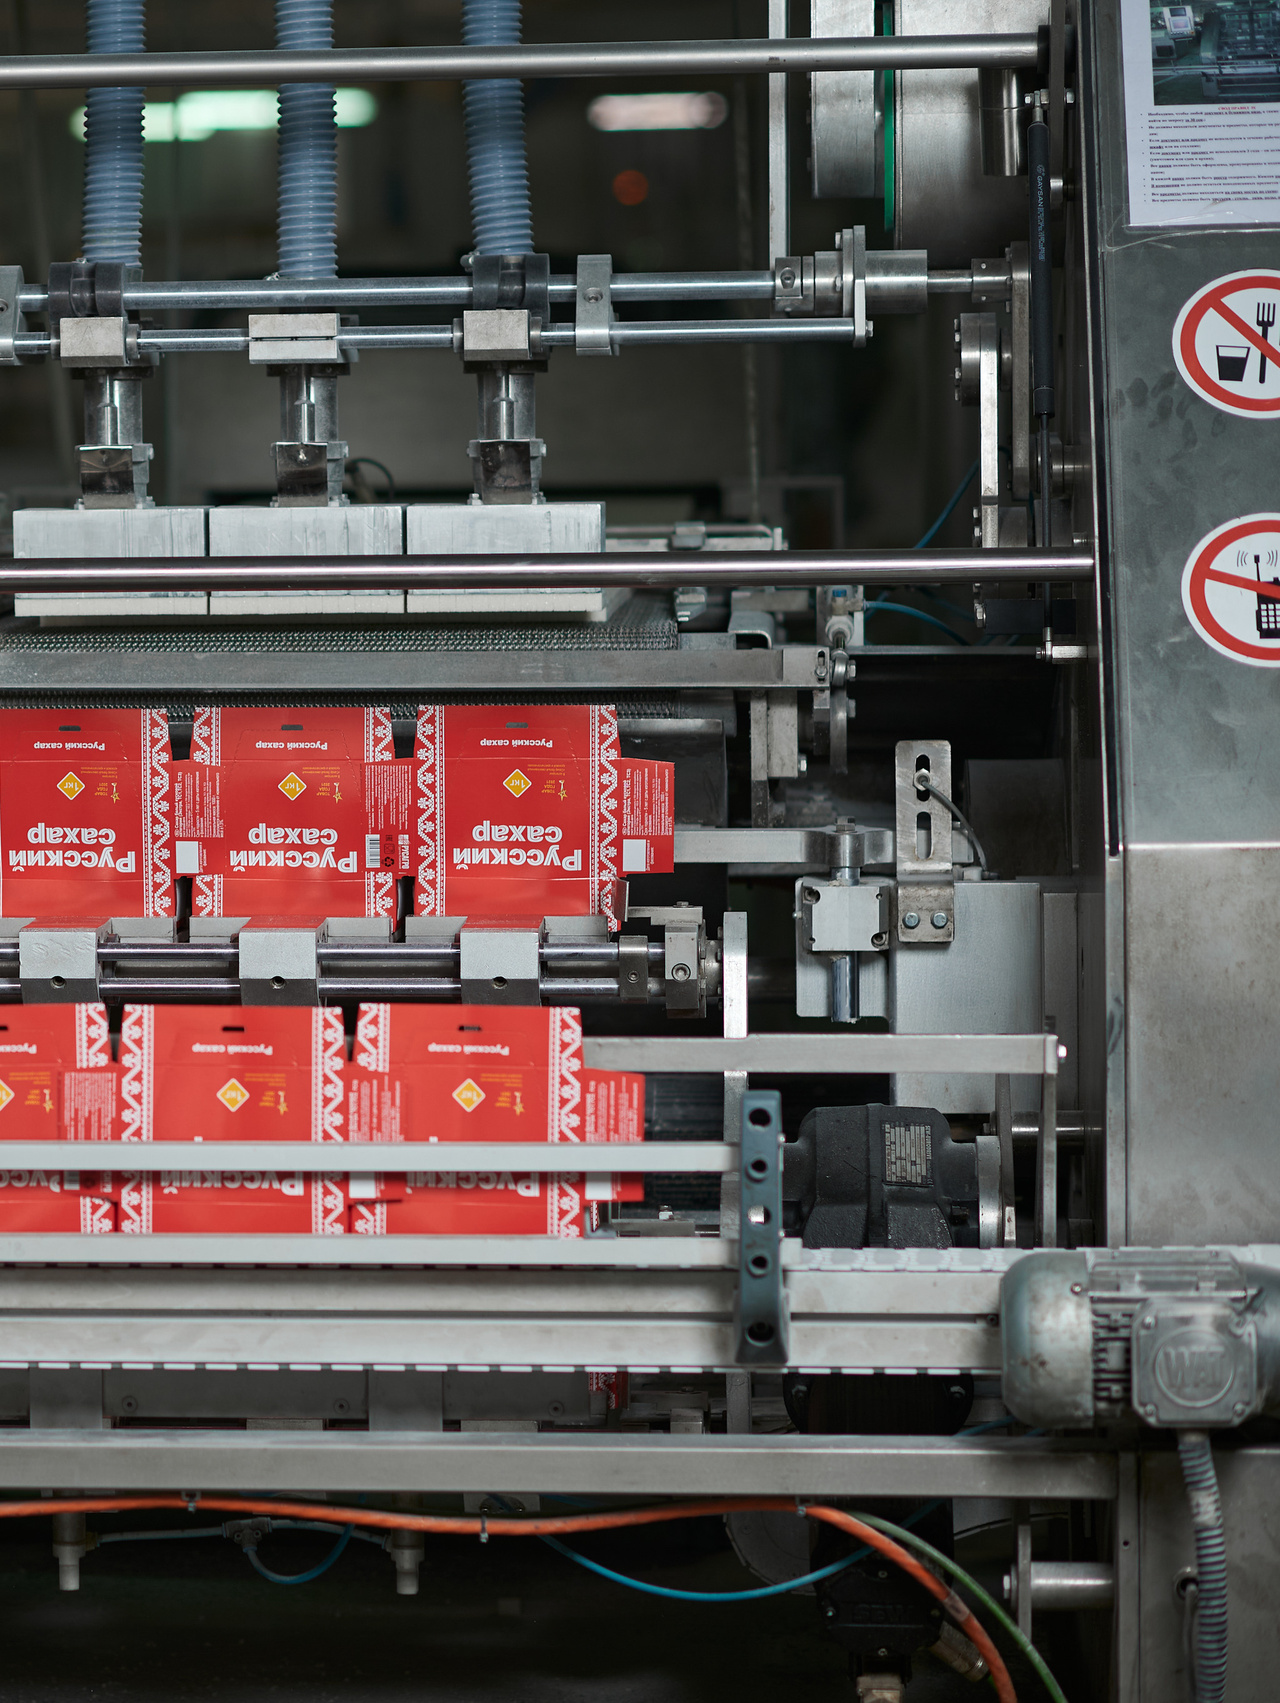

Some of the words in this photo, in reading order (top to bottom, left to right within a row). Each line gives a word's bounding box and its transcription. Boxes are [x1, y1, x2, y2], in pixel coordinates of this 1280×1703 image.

[33, 741, 63, 749] сахар
[64, 741, 106, 751] Русский
[255, 741, 285, 749] сахар
[286, 741, 328, 751] Русский
[480, 738, 510, 746] сахар
[511, 738, 553, 748] Русский
[27, 823, 116, 845] сахар
[248, 823, 338, 845] сахар
[472, 820, 563, 843] сахар
[9, 847, 136, 873] Русский
[229, 847, 358, 873] Русский
[401, 845, 410, 870] РУСАГРО
[453, 845, 582, 872] Русский
[227, 1043, 273, 1056] Русский
[463, 1044, 510, 1056] Русский
[161, 1170, 305, 1196] Русский
